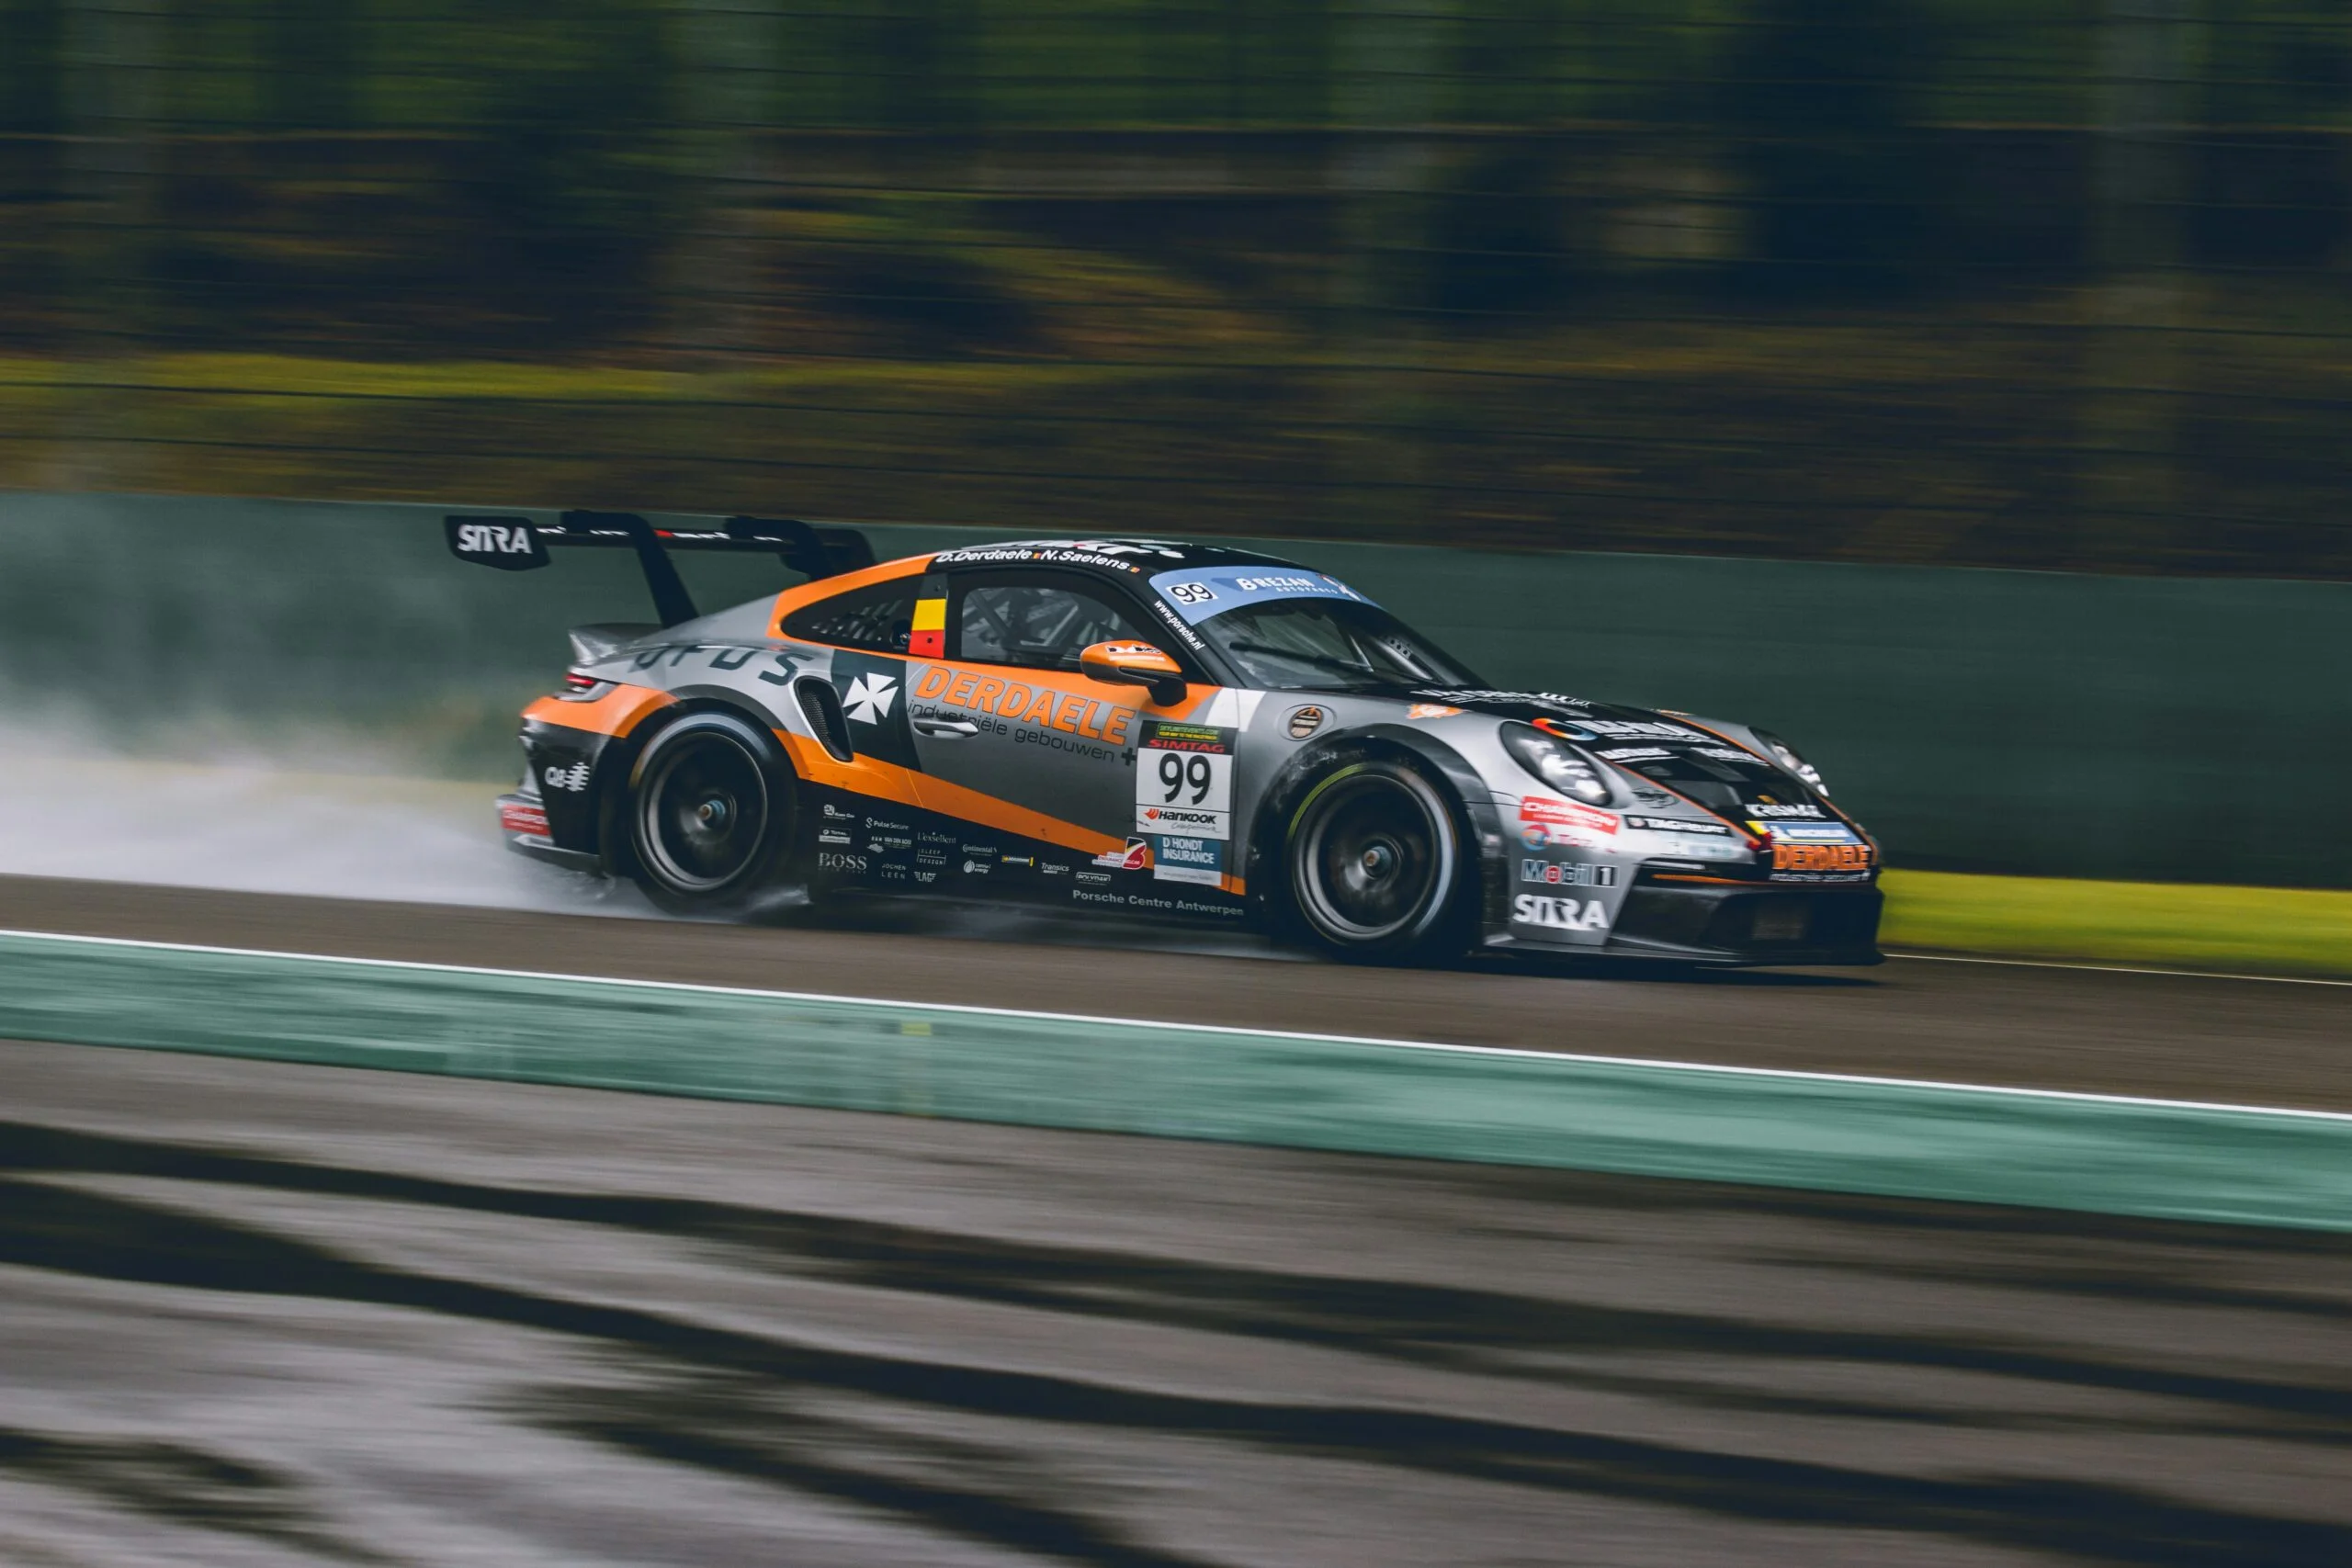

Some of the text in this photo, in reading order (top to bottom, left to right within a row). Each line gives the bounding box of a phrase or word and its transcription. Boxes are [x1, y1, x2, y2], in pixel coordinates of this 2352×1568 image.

[935, 549, 1130, 570] D.Derdaele N.Saelens
[1170, 583, 1214, 603] 99
[1236, 578, 1316, 591] BREZAN
[1154, 600, 1206, 651] www.porsche.nl
[914, 666, 1136, 746] DERDAELE
[1014, 728, 1115, 763] gebouwen
[1148, 738, 1226, 753] SIMTAG
[1159, 752, 1212, 806] 99
[818, 852, 867, 870] BOSS
[1162, 848, 1215, 864] INSURANCE
[1041, 863, 1069, 872] Transics
[1521, 859, 1594, 883] Mobil
[1072, 889, 1245, 917] Porsche Centre Antwerpen
